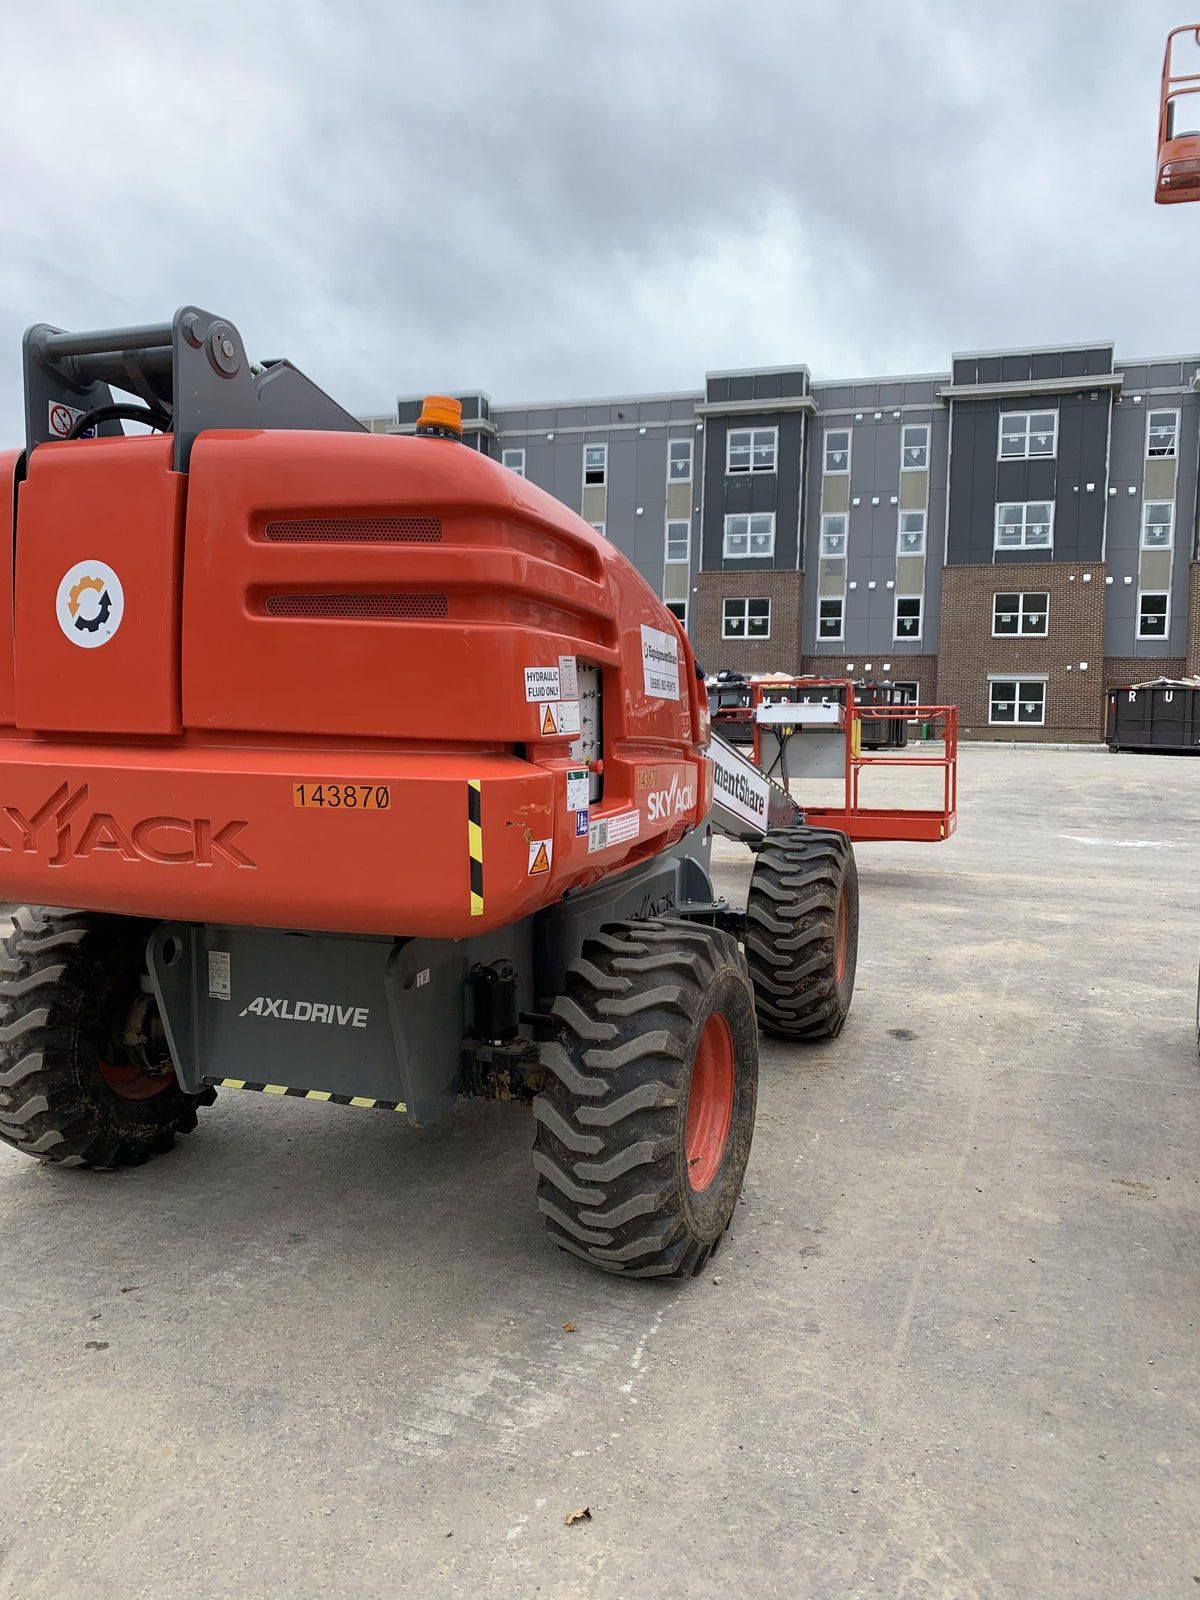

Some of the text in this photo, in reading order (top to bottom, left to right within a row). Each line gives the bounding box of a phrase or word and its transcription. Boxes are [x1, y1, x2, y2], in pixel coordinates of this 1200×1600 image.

[526, 671, 559, 682] HYDRAULIC
[528, 686, 559, 697] FLUID ONLY
[295, 784, 391, 810] 143870
[706, 752, 765, 816] mentShare
[238, 996, 370, 1029] AXLDRIVE
